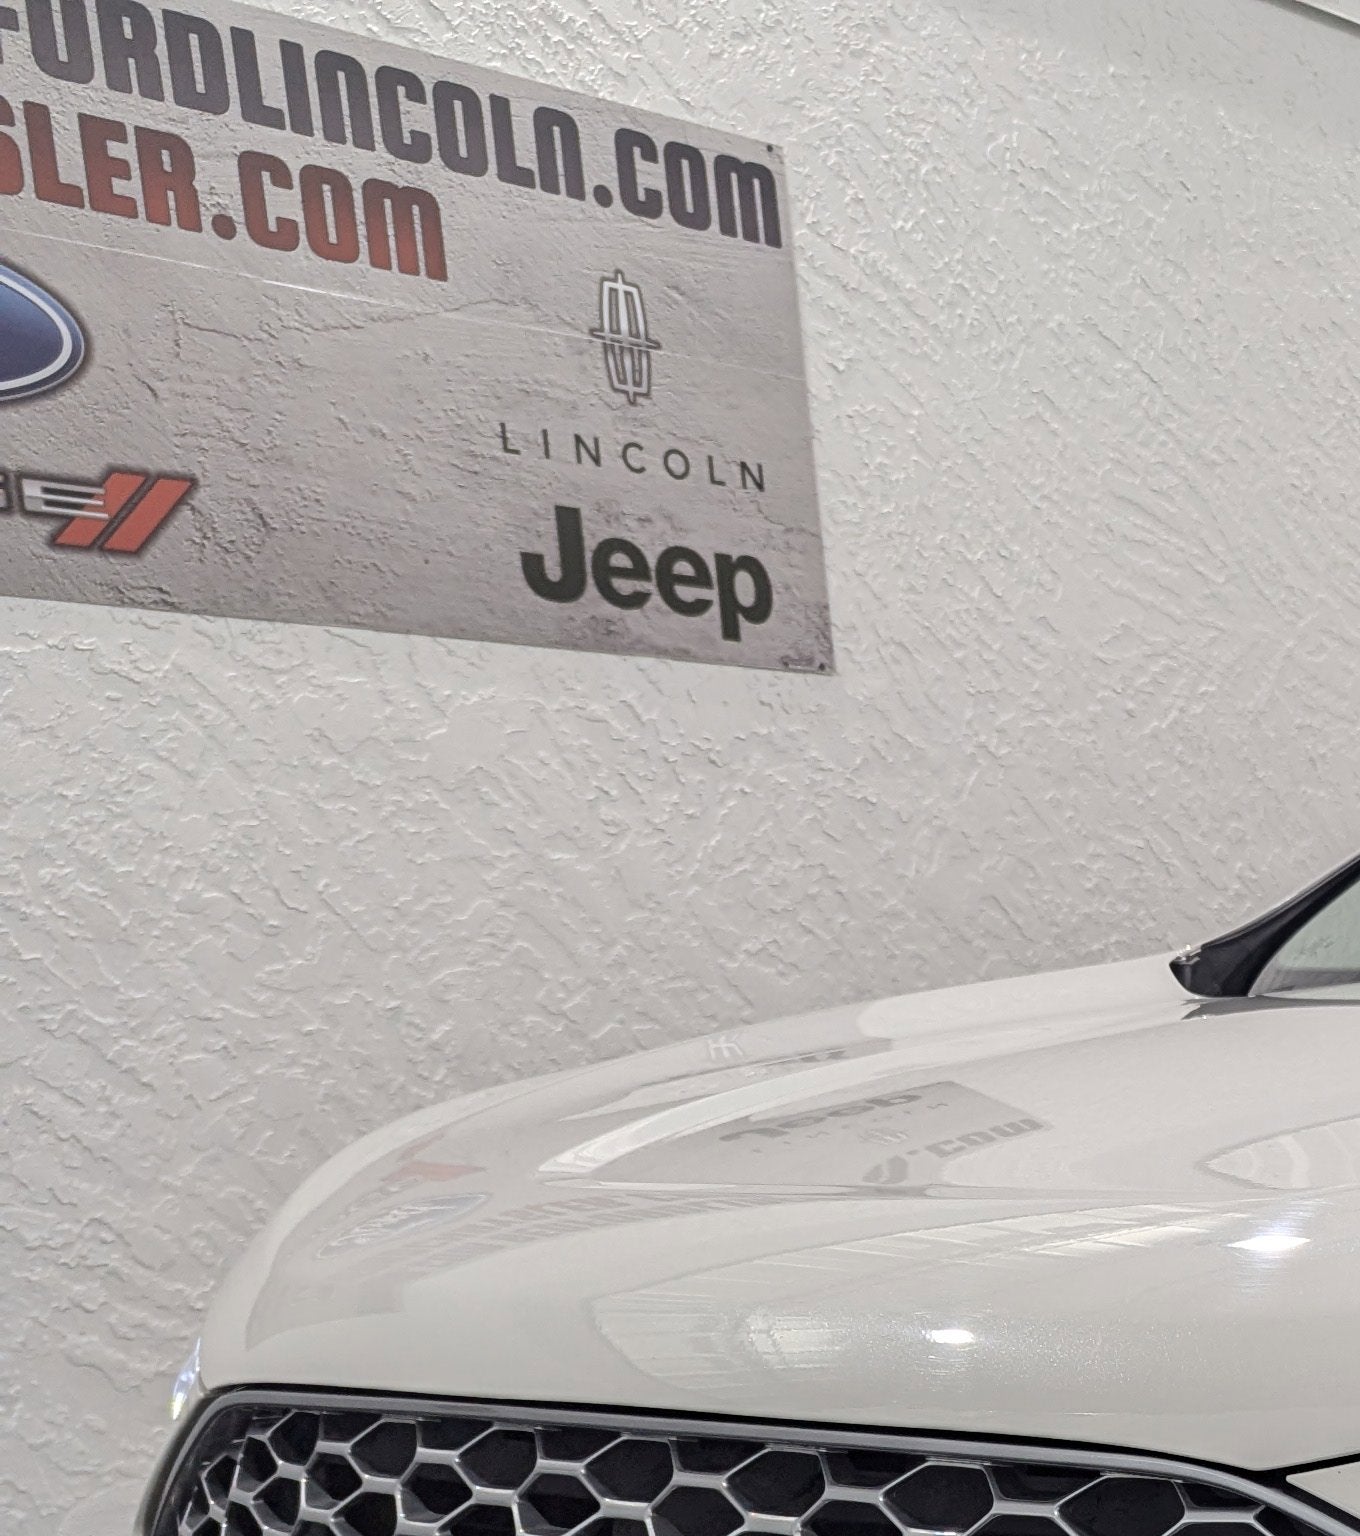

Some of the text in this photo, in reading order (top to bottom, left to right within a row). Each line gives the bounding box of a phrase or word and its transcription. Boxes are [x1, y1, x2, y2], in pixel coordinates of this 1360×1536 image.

[0, 0, 783, 249] ORDLINCOLN.COM
[499, 422, 766, 492] LINCOLN
[519, 505, 774, 643] Jeep
